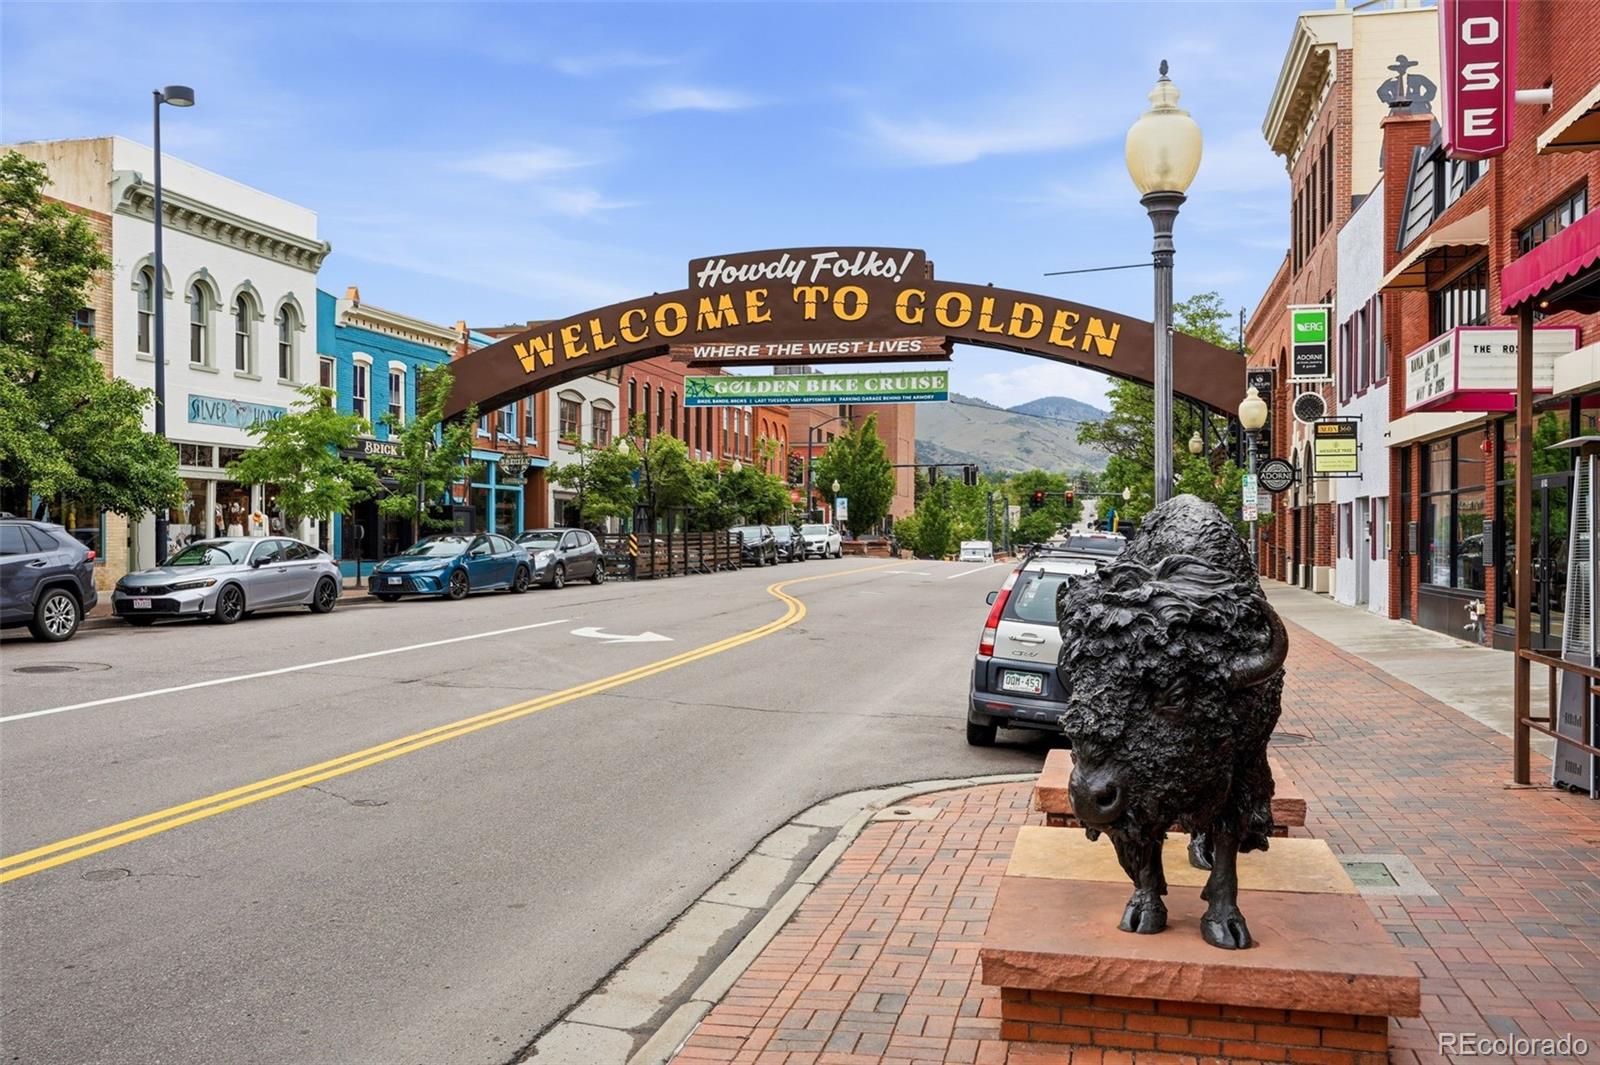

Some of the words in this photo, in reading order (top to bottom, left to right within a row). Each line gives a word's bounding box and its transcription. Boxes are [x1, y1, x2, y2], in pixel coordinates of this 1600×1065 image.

[697, 253, 807, 289] Howdy
[810, 251, 915, 283] Folks!
[512, 287, 772, 373] WELCOME
[792, 284, 870, 323] TO
[894, 287, 1122, 358] GOLDEN
[693, 342, 761, 358] WHERE
[765, 343, 804, 356] THE
[807, 340, 864, 356] WEST
[866, 340, 923, 354] LIVES
[1473, 345, 1491, 354] THE
[714, 379, 801, 394] GOLDEN
[806, 378, 859, 392] BIKE
[864, 376, 945, 391] CRUISE
